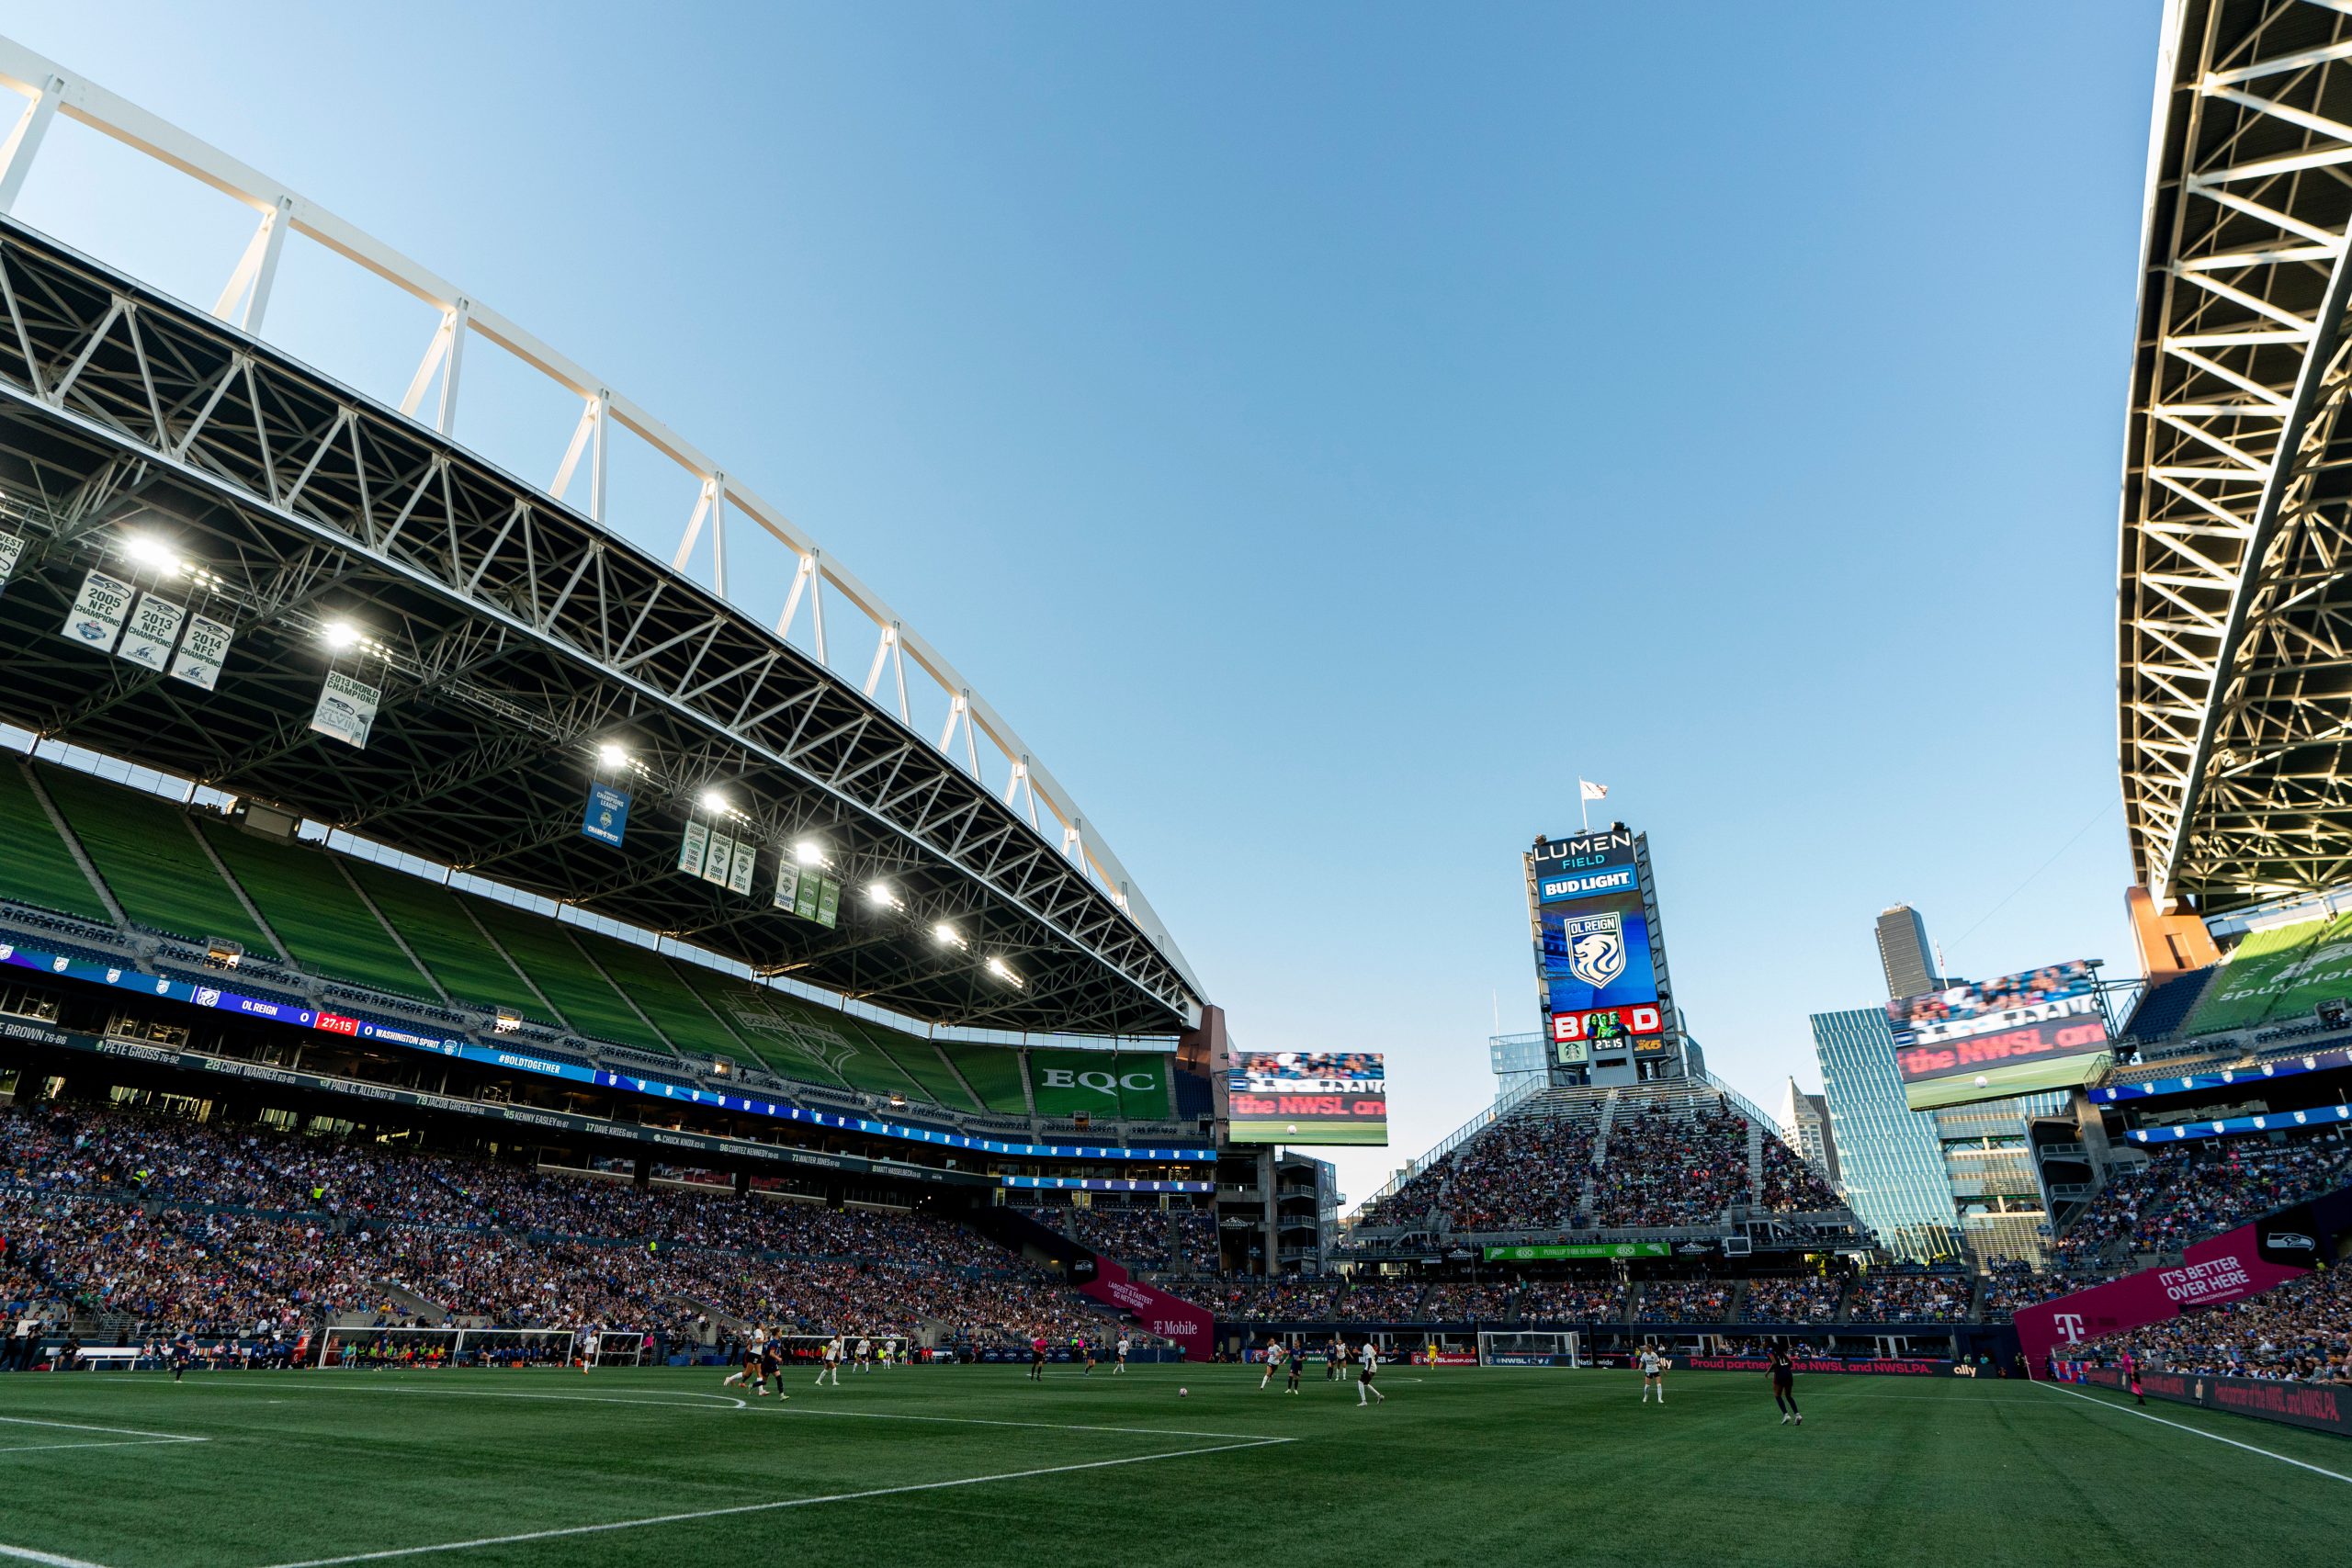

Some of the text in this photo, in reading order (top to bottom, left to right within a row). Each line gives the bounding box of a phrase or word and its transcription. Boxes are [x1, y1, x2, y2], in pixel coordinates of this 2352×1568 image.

[88, 588, 121, 608] 2005
[89, 600, 113, 615] NFC
[74, 604, 120, 627] CHAMPIONS
[141, 610, 173, 630] 2013
[128, 626, 173, 649] CHAMPIONS
[141, 622, 164, 637] NFC
[192, 631, 222, 650] 2014
[193, 643, 214, 657] NFC
[179, 647, 221, 668] CHAMPIONS
[327, 680, 377, 705] CHAMPIONS
[330, 673, 379, 698] 2013 WORLD
[317, 707, 356, 730] XLVIII
[597, 791, 624, 807] CHAMPIONS
[600, 799, 617, 811] LEAGUE
[712, 837, 731, 849] CHAMPS
[1534, 831, 1631, 862] LUMEN
[736, 847, 754, 859] CHAMPS
[1562, 854, 1605, 870] FIELD
[1544, 880, 1580, 897] BUD
[775, 893, 795, 905] CHAMPS
[1571, 918, 1615, 934] OL REIGN
[242, 1000, 278, 1016] OL REIGN
[322, 1017, 352, 1032] 27:15
[1555, 1008, 1659, 1039] BOD
[5, 1023, 67, 1045] BROWN 76-86
[375, 1028, 419, 1045] WASHINGTON
[419, 1037, 440, 1049] SPIRIT
[103, 1041, 180, 1065] PETE GROSS 76-92
[1596, 1038, 1623, 1050] 27:15
[1909, 1048, 1956, 1074] the
[1956, 1029, 2053, 1066] NWSL
[204, 1059, 296, 1084] 28 CURT WARNER 83-89
[499, 1054, 560, 1074] #BOLDTOGETHER
[331, 1080, 348, 1092] PAUL
[350, 1085, 357, 1094] G.
[358, 1086, 380, 1098] ALLEN
[379, 1091, 395, 1100] 97-18
[1041, 1068, 1156, 1097] EQC
[416, 1095, 427, 1106] 79
[427, 1097, 448, 1110] JACOB
[449, 1100, 471, 1113] GREEN
[1236, 1094, 1276, 1114] the
[1278, 1096, 1351, 1115] NWSL
[503, 1108, 514, 1120] 45
[514, 1111, 536, 1123] KENNY
[535, 1114, 558, 1127] EASLEY
[584, 1122, 594, 1132] 17
[594, 1123, 608, 1134] DAVE
[608, 1126, 627, 1137] KRIEG
[662, 1134, 680, 1145] CHUCK
[679, 1137, 695, 1147] KNOX
[728, 1145, 747, 1155] CORTEZ
[746, 1147, 768, 1158] KENNEDY
[798, 1155, 817, 1165] WALTER
[816, 1157, 831, 1167] JONES
[2185, 1256, 2241, 1280] BETTER
[1108, 1280, 1129, 1295] LARGEST
[1133, 1292, 1153, 1305] FASTEST
[2166, 1280, 2210, 1301] OVER
[2207, 1269, 2250, 1291] HERE
[1113, 1291, 1144, 1310] 5G NETWORK
[1164, 1321, 1197, 1335] Mobile
[1577, 1359, 1614, 1367] Natiwide
[1657, 1358, 1672, 1370] lly
[1690, 1359, 1933, 1374] Proud partner he NWSL and NWSLPA.
[1953, 1364, 1976, 1378] ally
